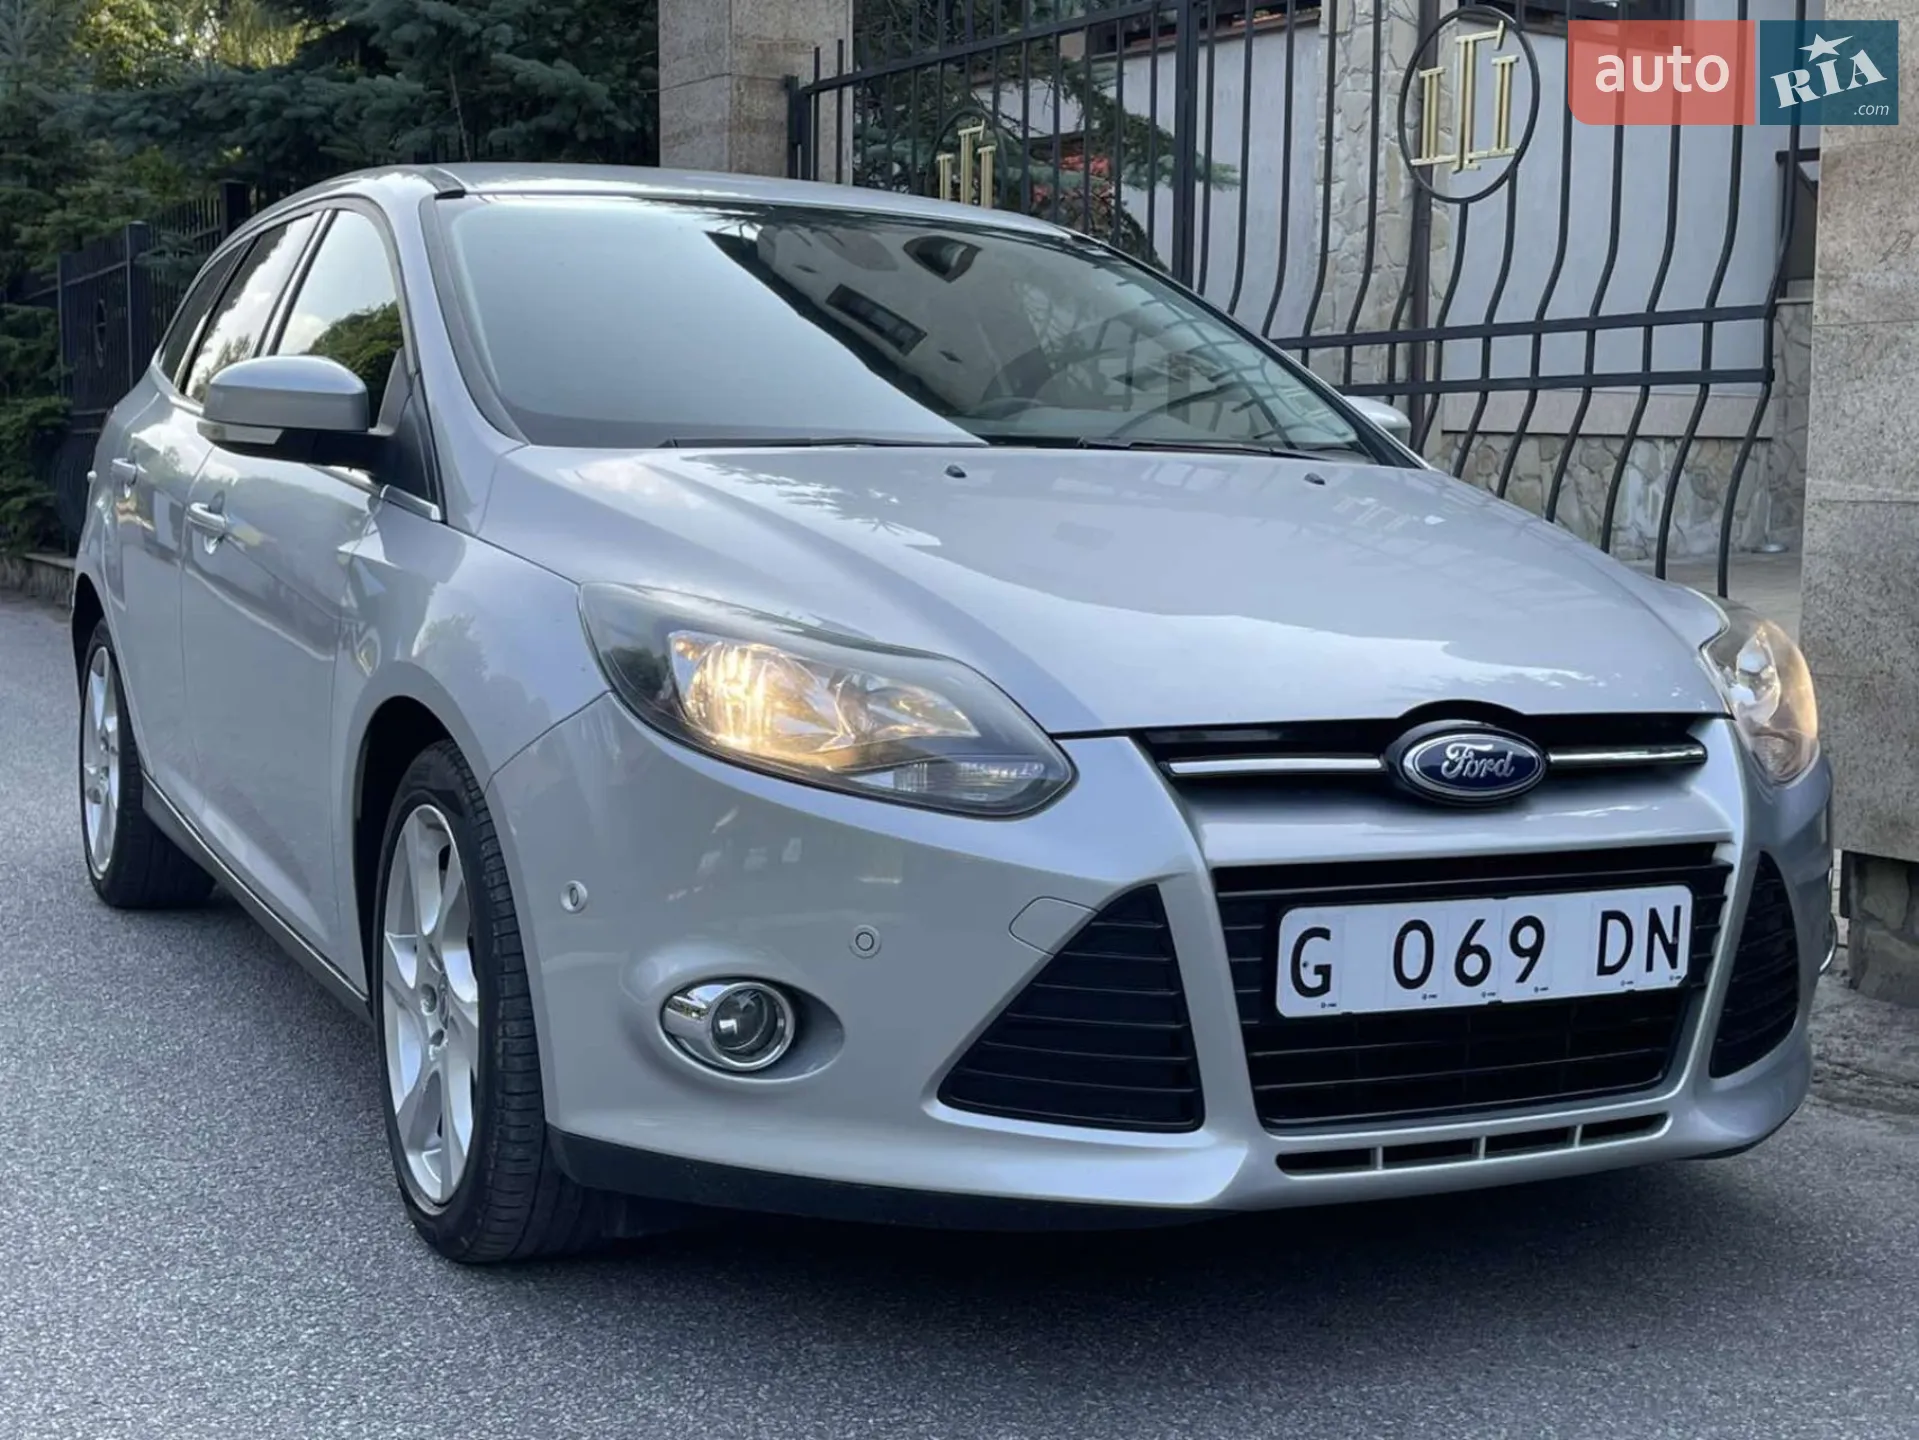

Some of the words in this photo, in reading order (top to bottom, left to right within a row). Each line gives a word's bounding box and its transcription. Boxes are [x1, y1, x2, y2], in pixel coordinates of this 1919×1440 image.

[1441, 742, 1515, 779] Ford
[1290, 927, 1332, 998] G
[1393, 915, 1546, 990] 069
[1597, 905, 1682, 976] DN
